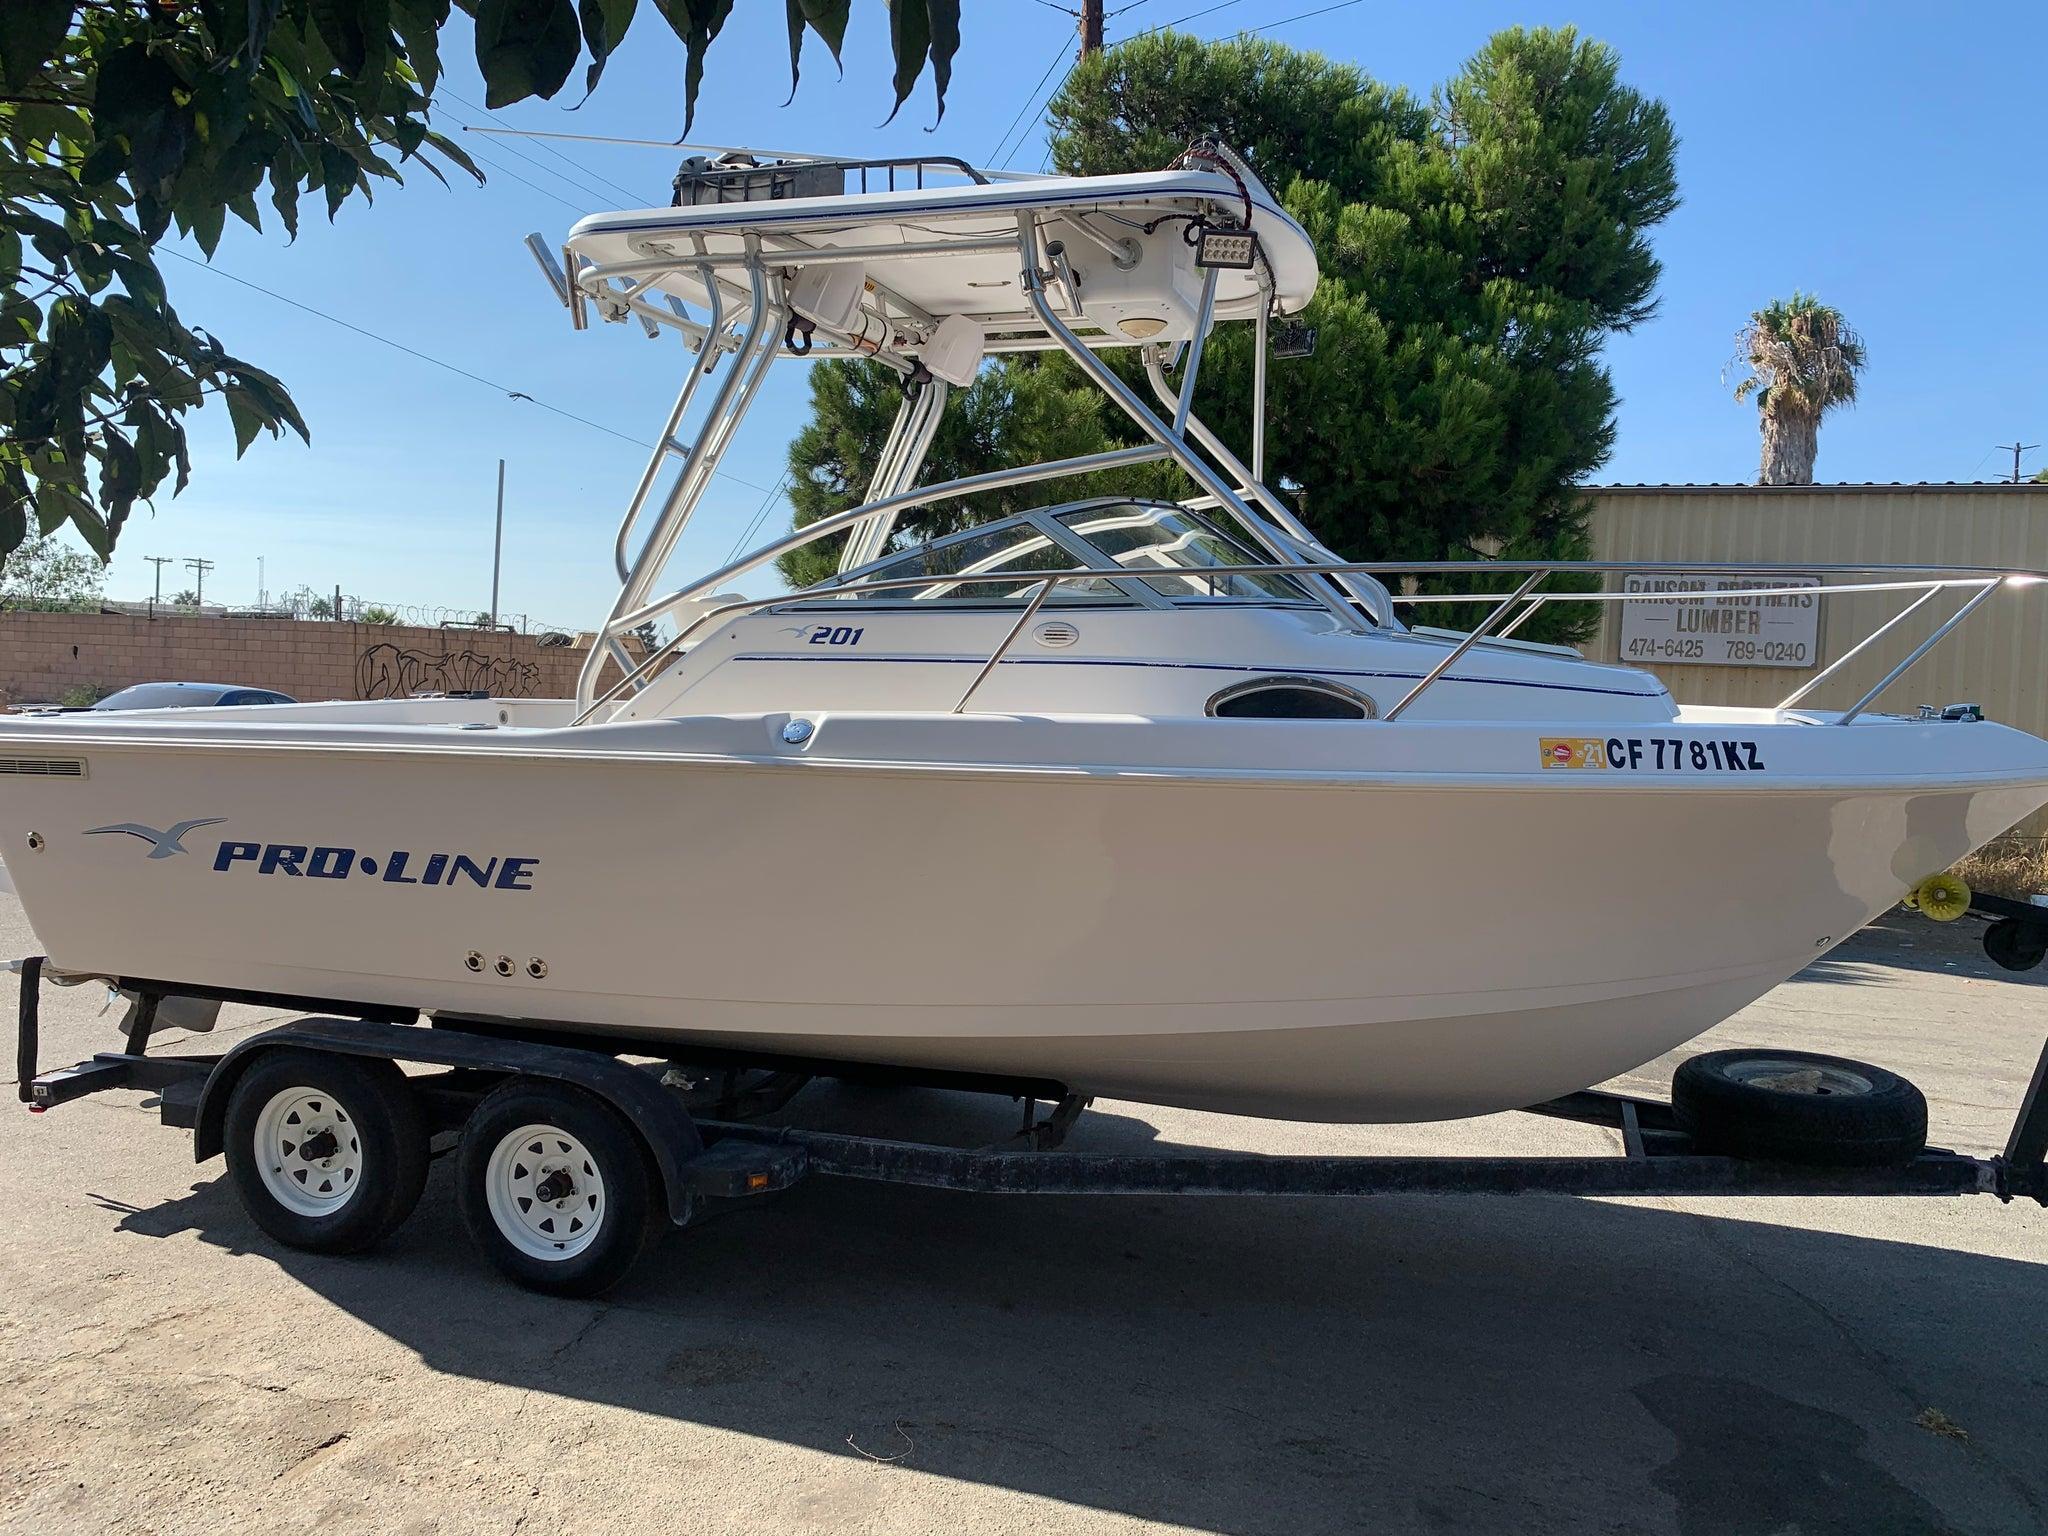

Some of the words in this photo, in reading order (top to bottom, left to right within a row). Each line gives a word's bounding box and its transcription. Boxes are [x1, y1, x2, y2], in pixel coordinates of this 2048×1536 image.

[1628, 579, 1706, 605] RANSOM
[1715, 580, 1814, 609] BROTHERS
[1676, 608, 1761, 634] LUMBER
[808, 625, 865, 646] 201
[1628, 638, 1704, 659] 474-6425
[1726, 640, 1806, 662] 789-0240
[1606, 738, 1643, 770] CF
